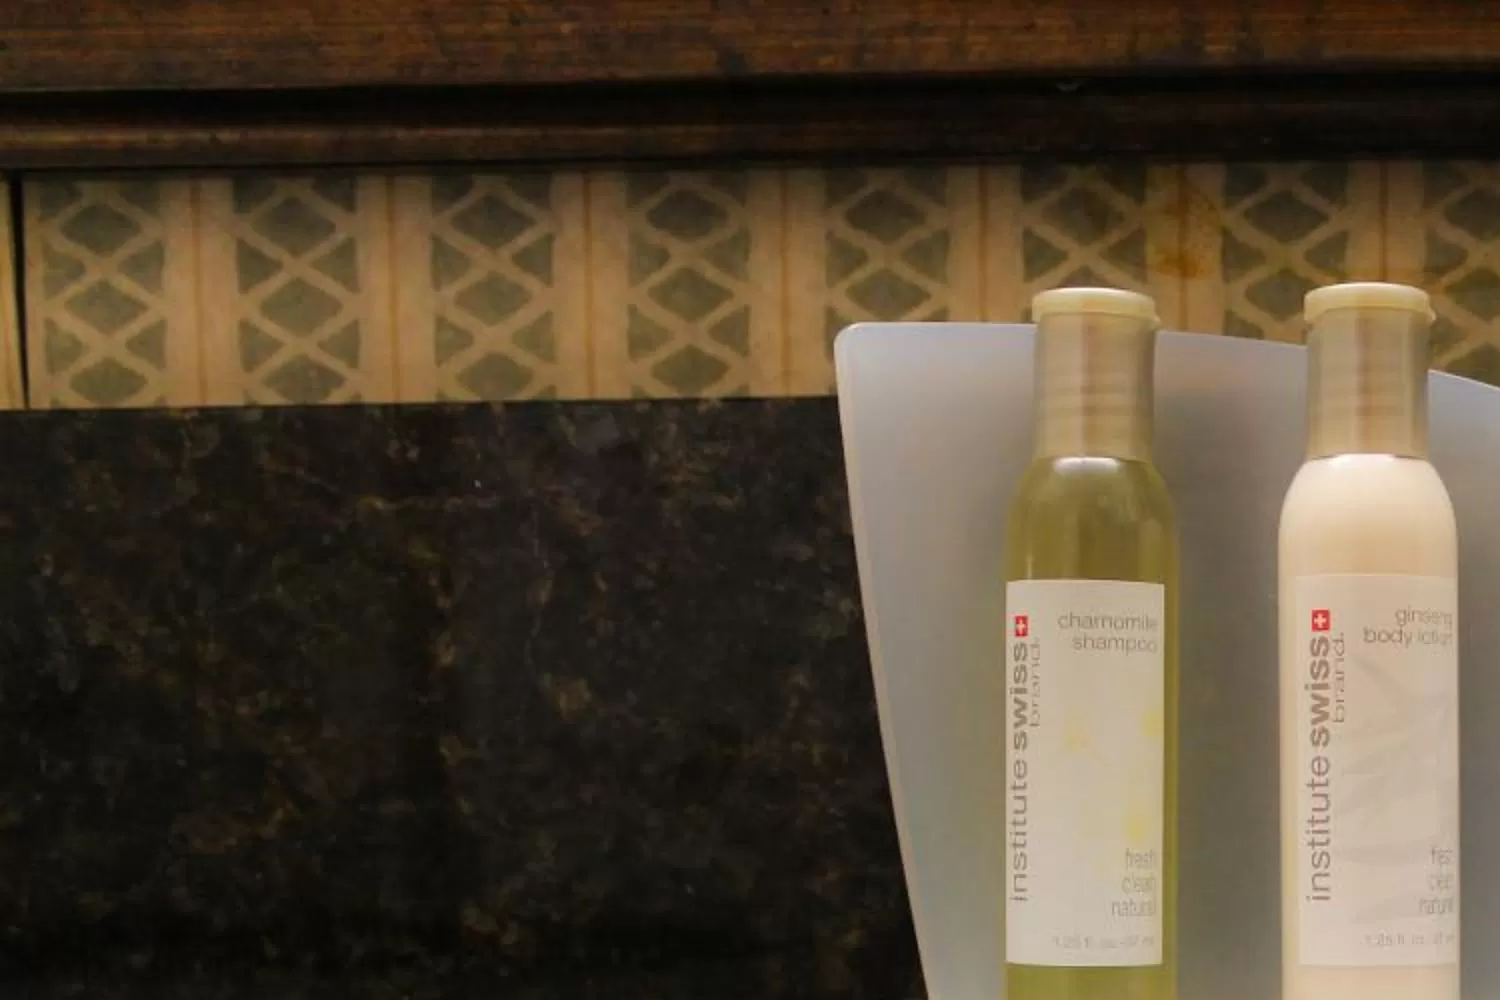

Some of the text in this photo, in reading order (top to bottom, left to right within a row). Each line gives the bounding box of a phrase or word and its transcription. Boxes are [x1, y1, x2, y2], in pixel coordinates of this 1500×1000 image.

[1057, 611, 1158, 631] chamomile
[1072, 635, 1158, 656] shampoo
[1363, 626, 1413, 649] body
[1009, 641, 1029, 902] institute swiss
[1304, 635, 1331, 902] institute swiss
